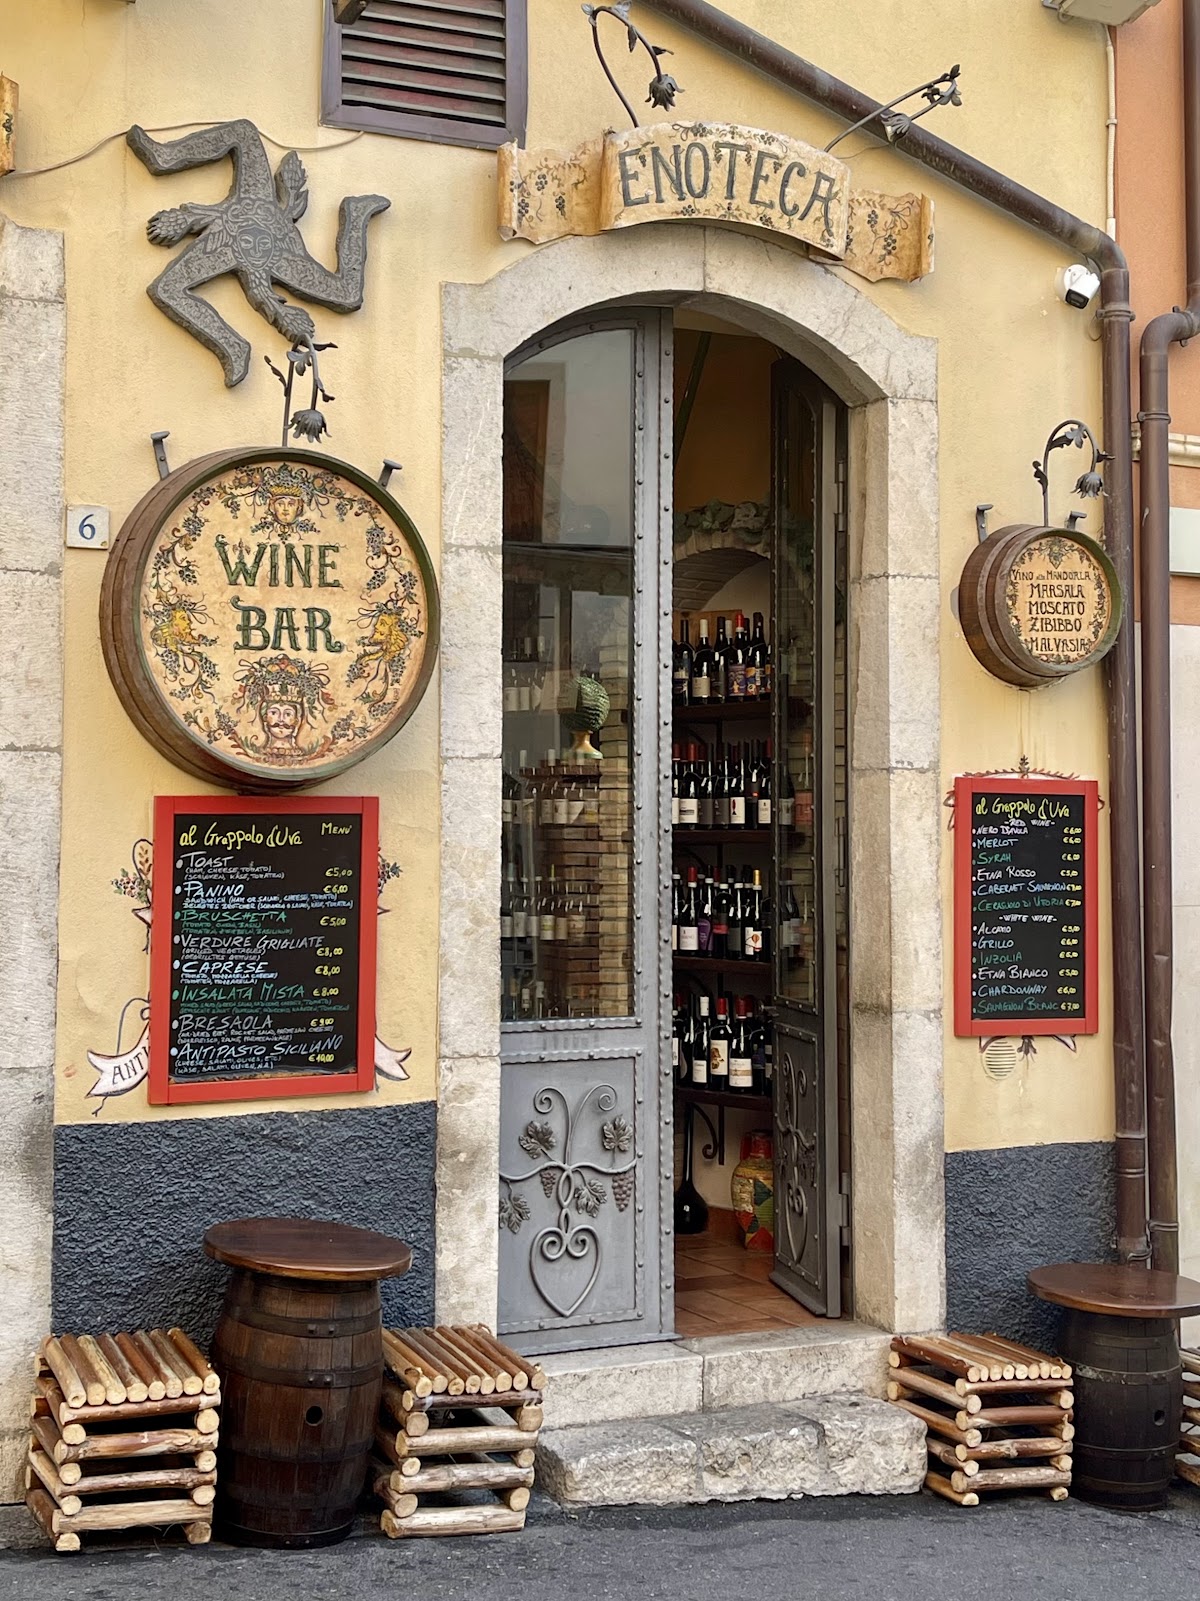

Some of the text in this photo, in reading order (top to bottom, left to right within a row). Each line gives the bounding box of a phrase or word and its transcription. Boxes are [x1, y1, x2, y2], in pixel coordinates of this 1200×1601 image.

[619, 142, 837, 237] ENOTECA
[79, 513, 97, 541] 6
[215, 534, 343, 588] WINE
[1011, 569, 1034, 581] VINO
[1029, 583, 1086, 599] MARSALA
[1028, 600, 1086, 616] MOSCATO
[230, 595, 344, 653] BAR
[1029, 616, 1083, 633] ZIBIBBO
[1029, 636, 1086, 653] MALVASIA
[976, 797, 989, 815] al
[991, 797, 1036, 819] Grappolo
[179, 824, 198, 846] al
[203, 822, 264, 850] Grappolo
[976, 837, 1019, 849] MERLOT
[180, 851, 235, 868] TOAST
[977, 852, 1012, 865] SYRAH
[976, 866, 1037, 881] ETNA ROSSO
[183, 881, 245, 898] PANINO
[977, 883, 1026, 896] CABERNET
[181, 911, 288, 923] BRUSCHETTA
[180, 934, 326, 951] VERDURE GRIGLIATE
[977, 936, 1015, 949] GRILLO
[980, 951, 1023, 966] INZOLIA
[182, 961, 269, 974] CAPRESE
[977, 964, 1049, 981] ETNA BIANCO
[181, 982, 306, 1002] INSALATA MISTA
[977, 984, 1048, 998] CHARDONNAY
[179, 1014, 274, 1032] BRESAOLA
[176, 1034, 345, 1060] ANTIPASTO SICILIANO
[112, 1045, 149, 1086] ANTI
